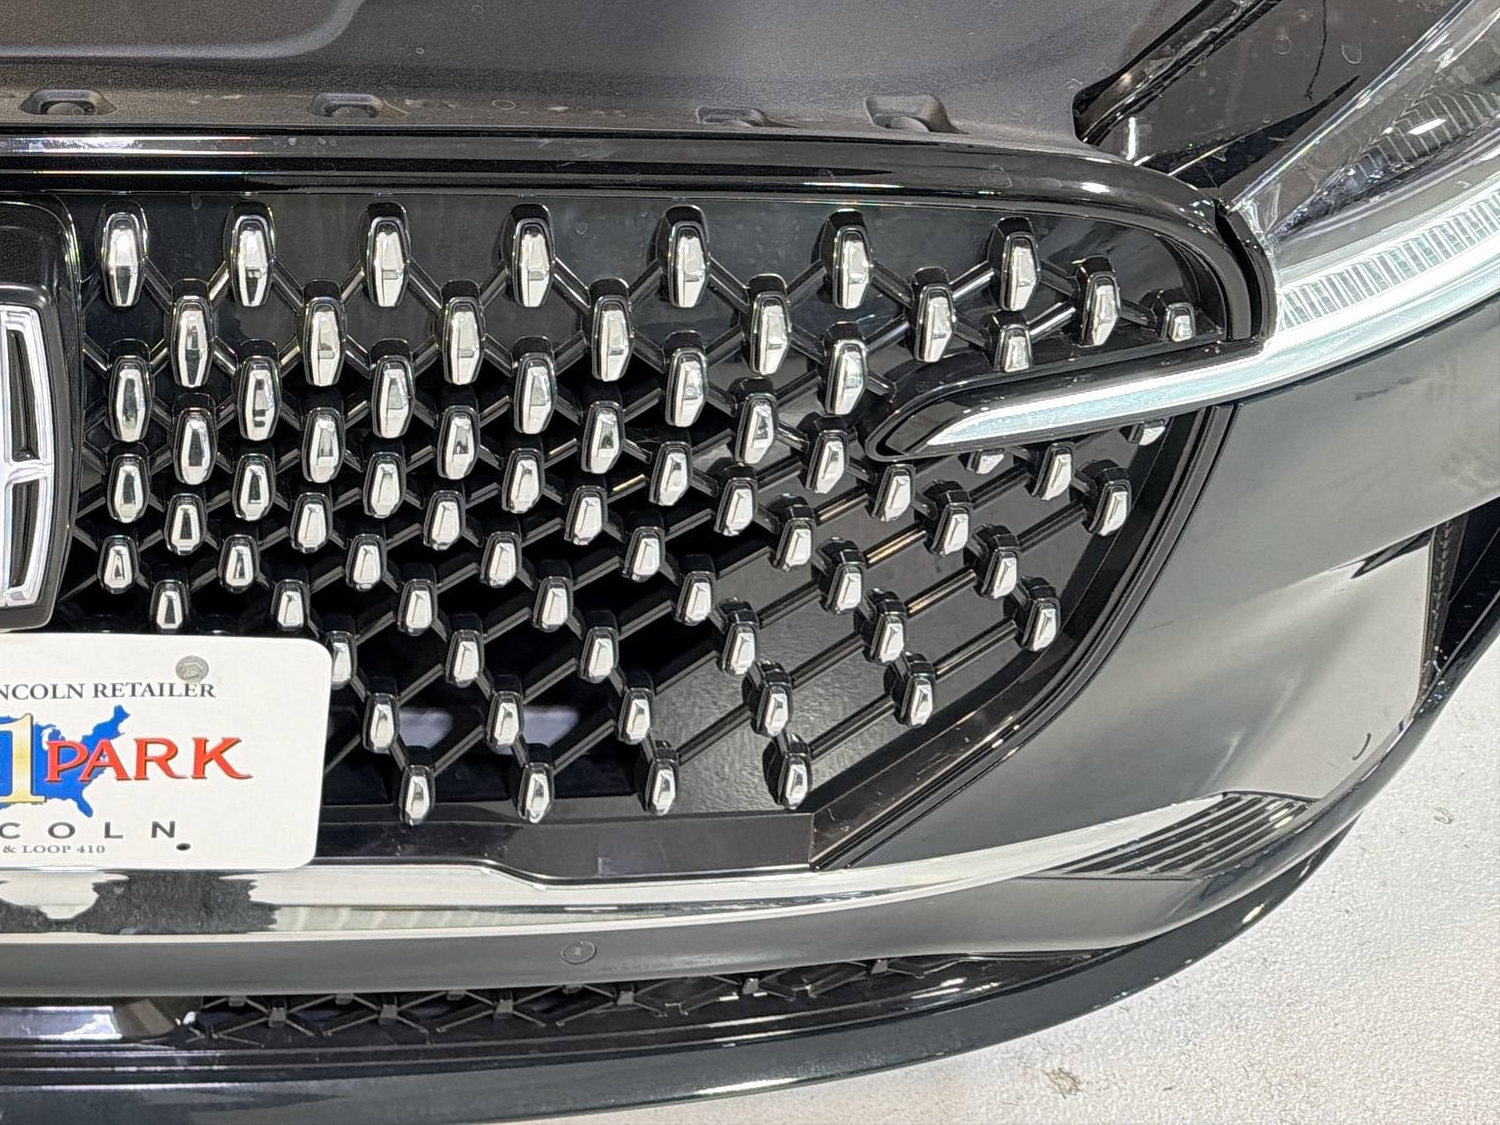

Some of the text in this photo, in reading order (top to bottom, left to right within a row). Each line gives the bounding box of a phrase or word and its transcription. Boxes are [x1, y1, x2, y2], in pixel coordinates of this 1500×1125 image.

[92, 682, 216, 699] RETAILER
[45, 737, 254, 783] PARK
[3, 845, 17, 853] &
[23, 845, 71, 853] LOOP
[76, 845, 105, 853] 410
